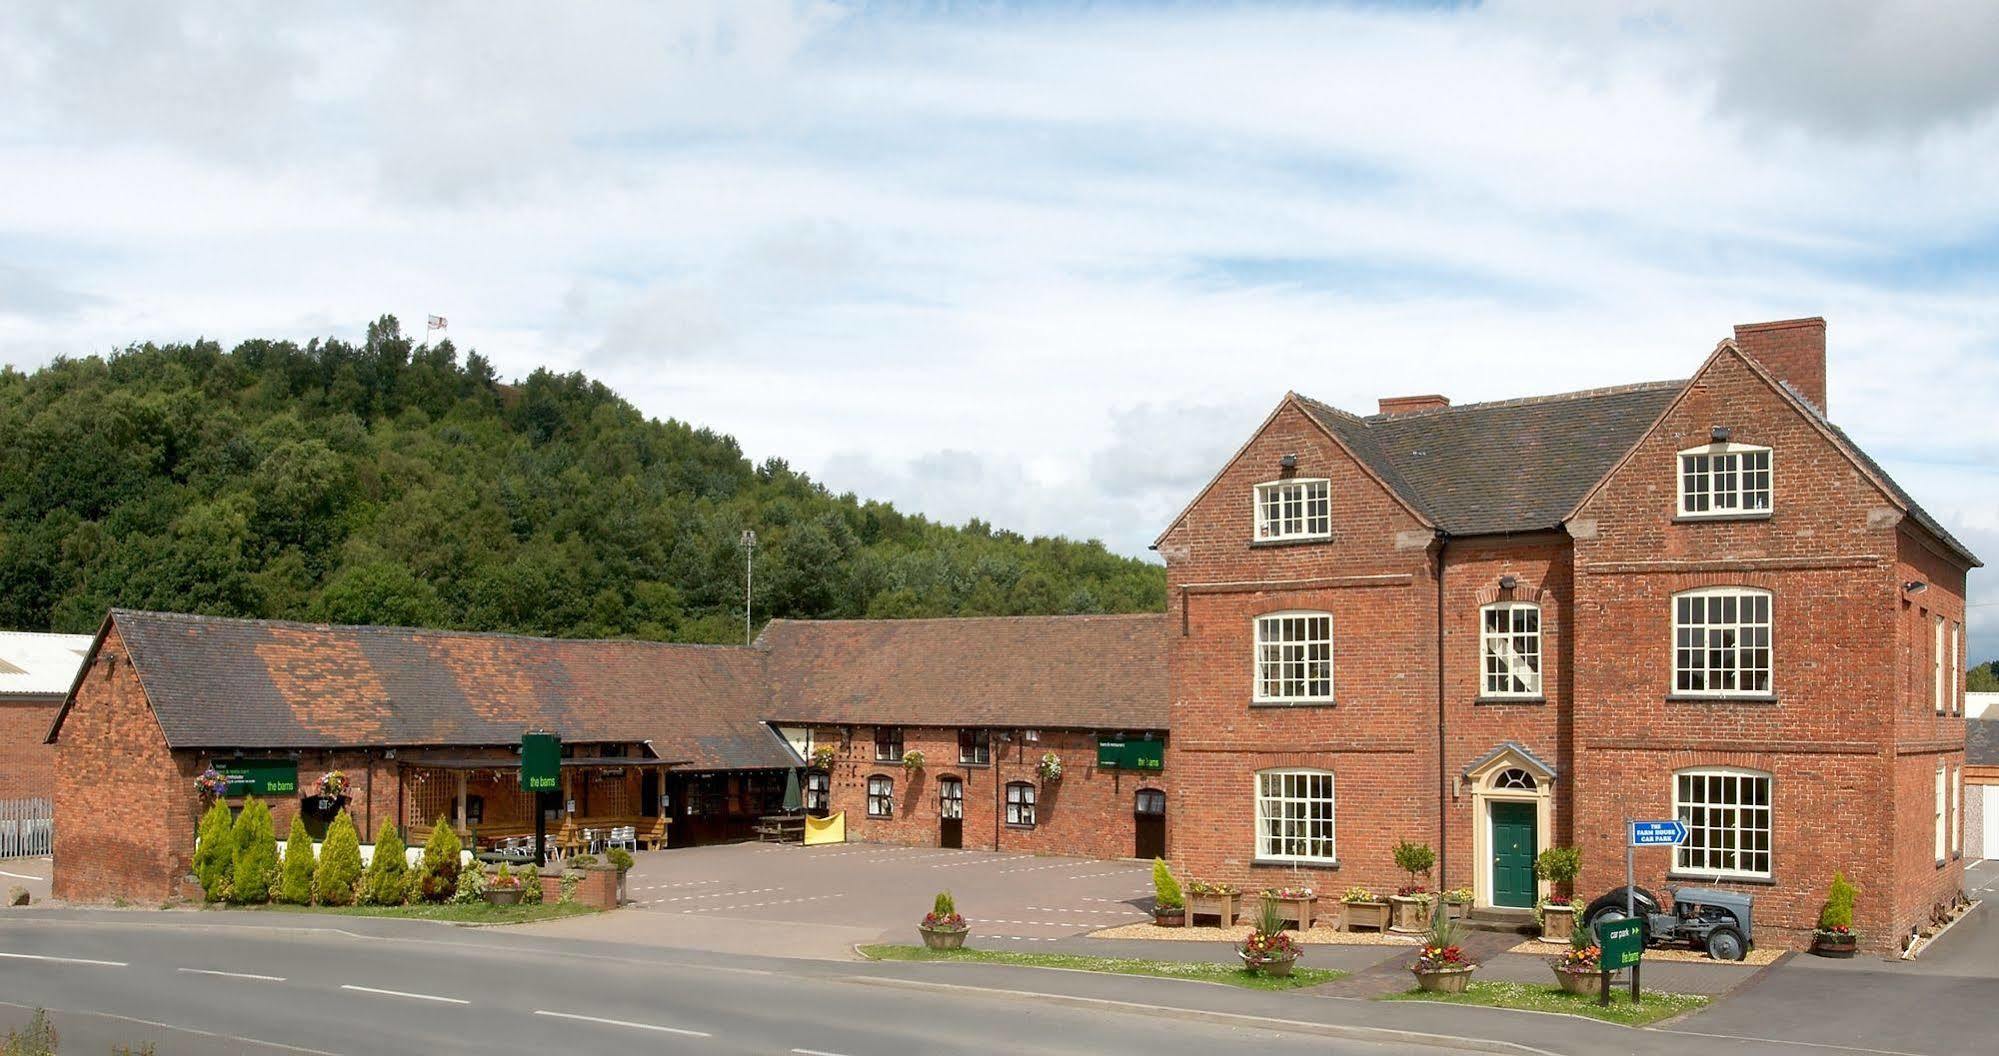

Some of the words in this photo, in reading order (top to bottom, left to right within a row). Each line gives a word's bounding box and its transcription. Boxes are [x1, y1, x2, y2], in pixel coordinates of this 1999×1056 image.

[267, 781, 277, 791] the
[277, 780, 294, 791] barns
[530, 776, 540, 788] the
[540, 776, 556, 787] barns
[1610, 931, 1618, 939] car
[1618, 928, 1630, 940] park
